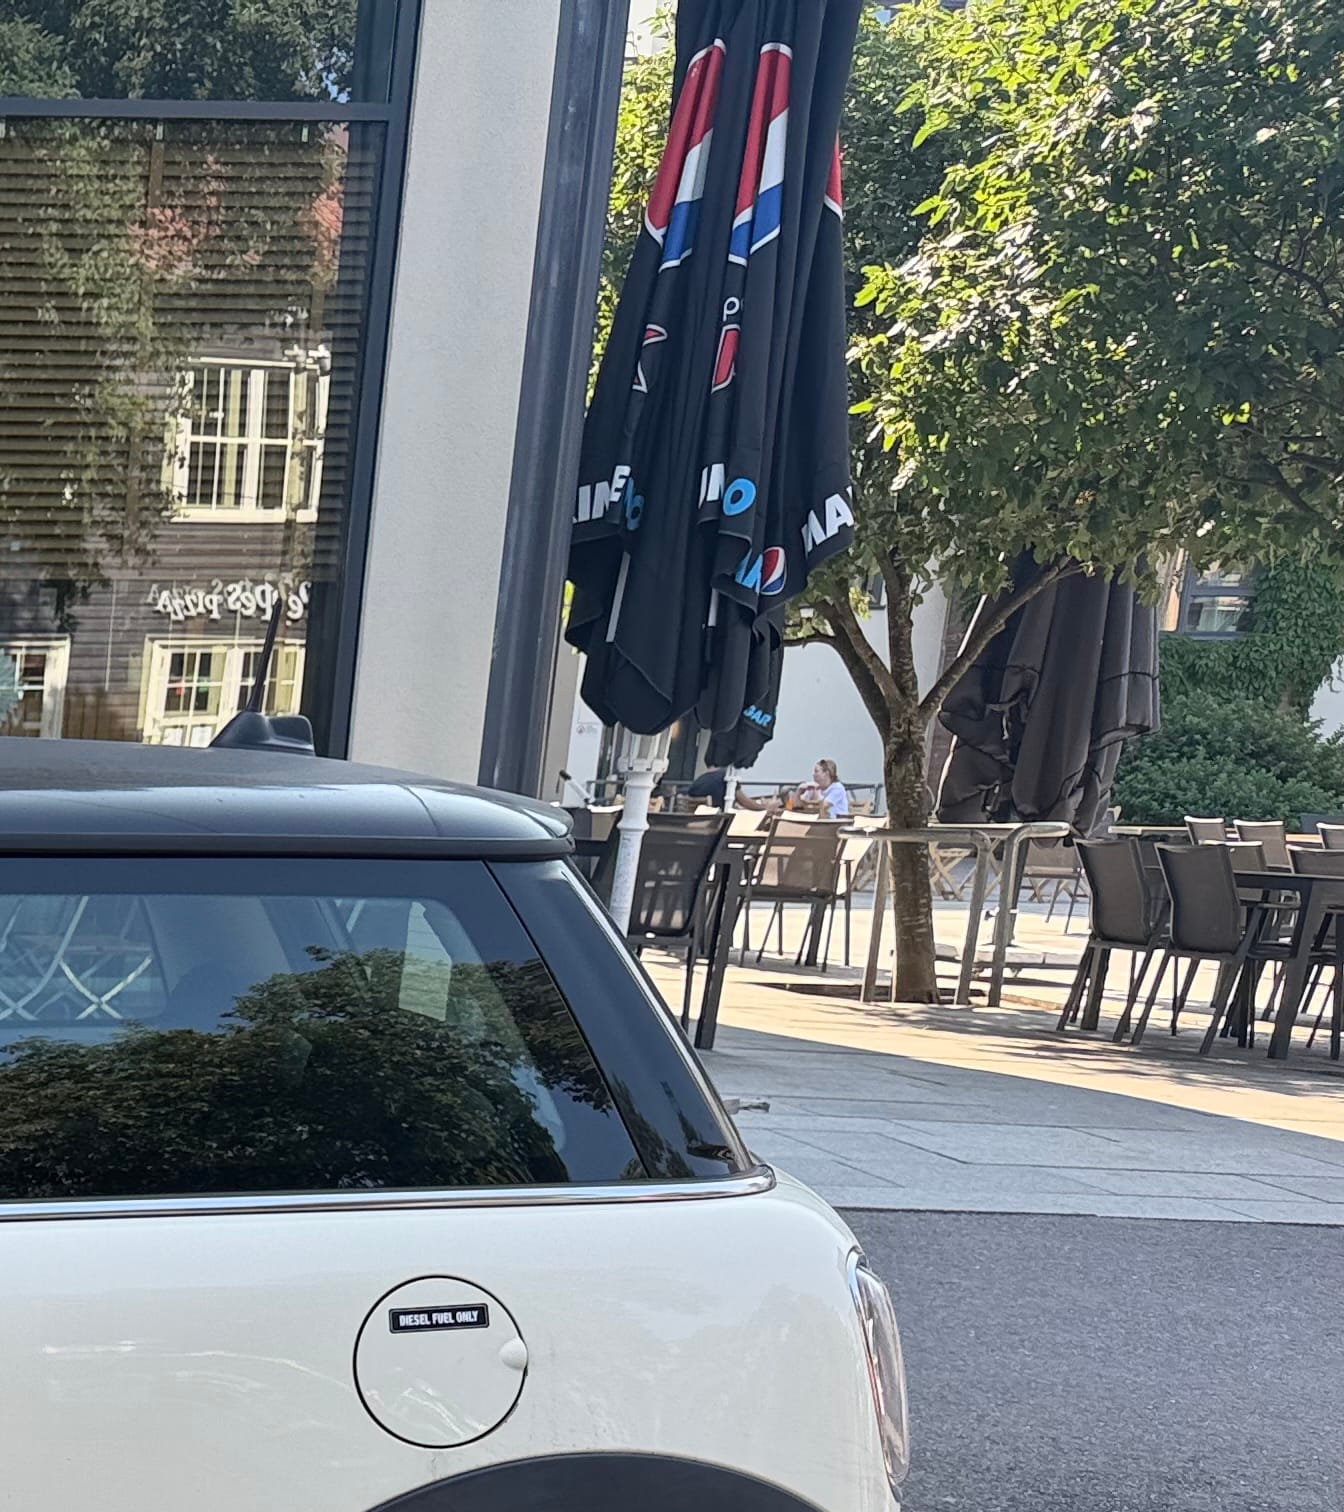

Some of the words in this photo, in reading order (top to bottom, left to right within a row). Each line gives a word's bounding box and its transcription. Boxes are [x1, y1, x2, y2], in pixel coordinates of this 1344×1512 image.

[399, 1314, 431, 1327] DIESEL
[432, 1312, 455, 1325] FUEL
[456, 1310, 479, 1323] ONLY
